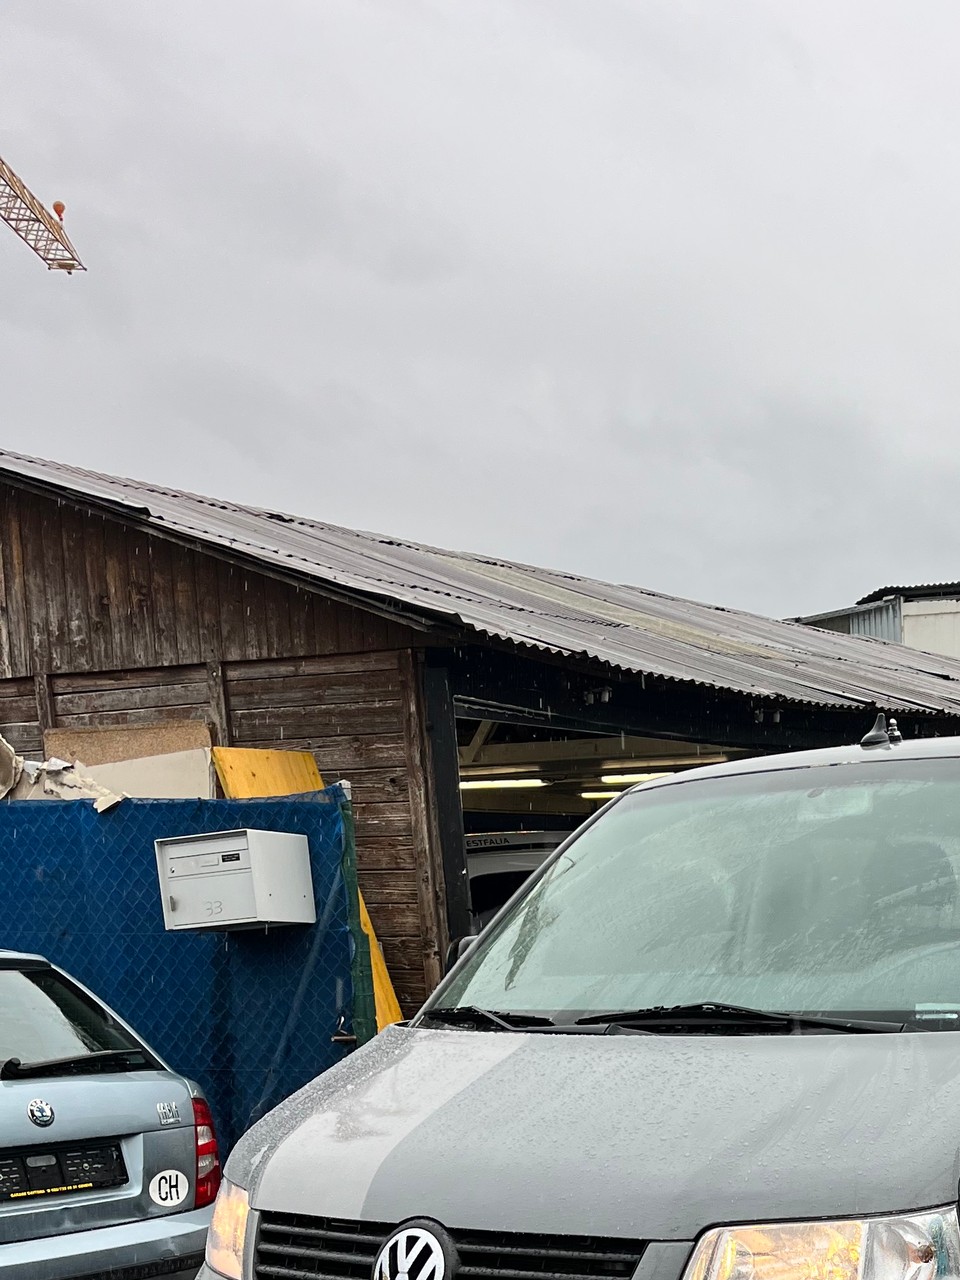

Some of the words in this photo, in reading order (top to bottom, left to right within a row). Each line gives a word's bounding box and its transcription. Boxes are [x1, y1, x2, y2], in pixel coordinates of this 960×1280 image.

[466, 838, 510, 848] ESTFALIA
[204, 900, 224, 917] 33
[158, 1174, 180, 1201] CH
